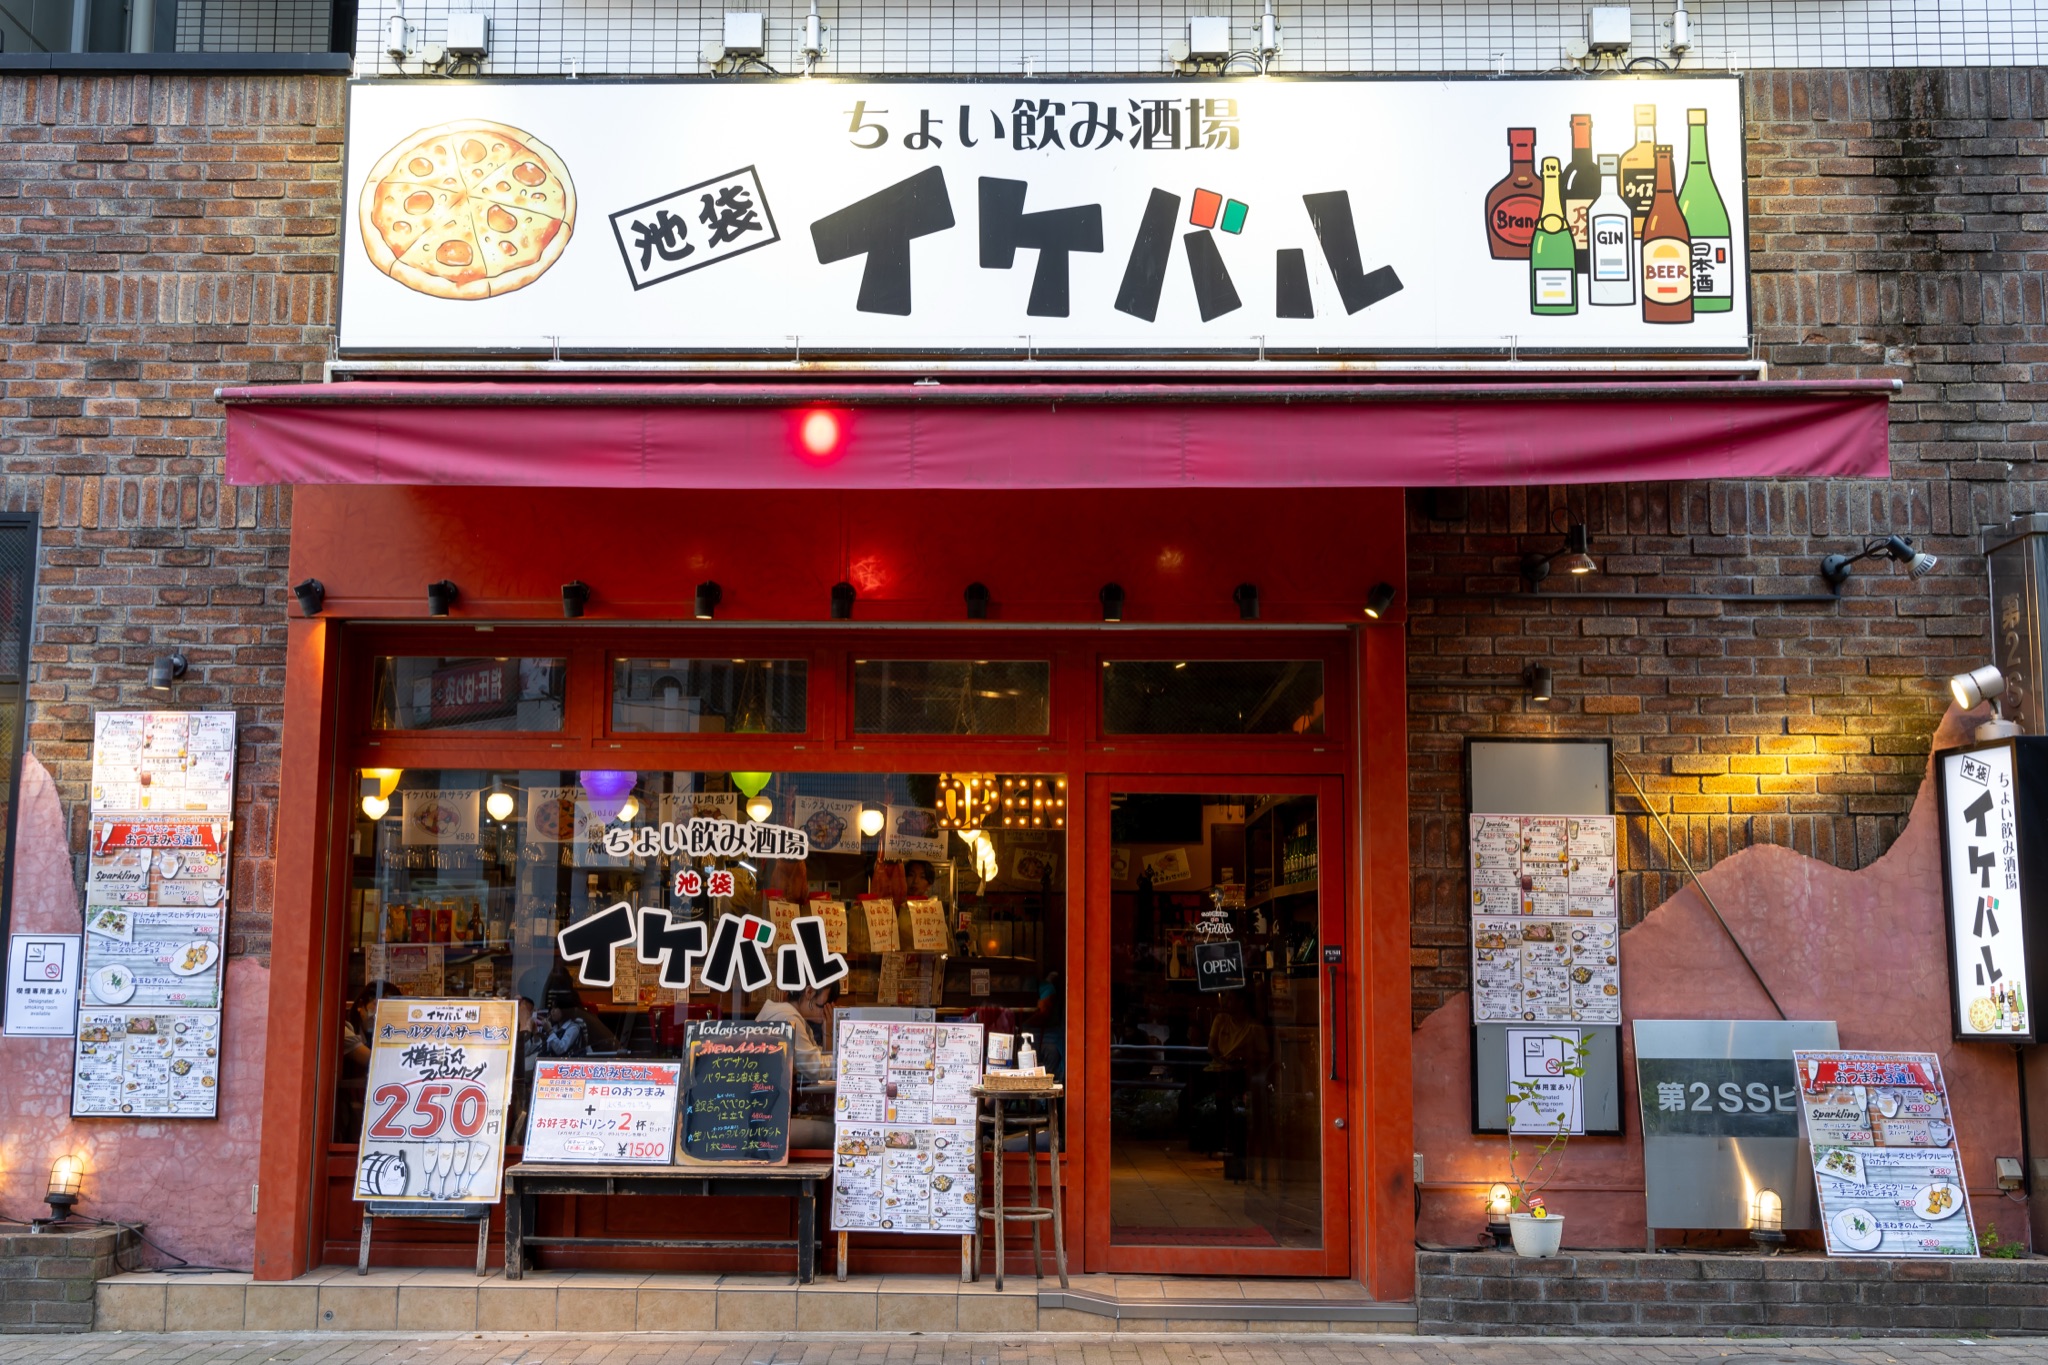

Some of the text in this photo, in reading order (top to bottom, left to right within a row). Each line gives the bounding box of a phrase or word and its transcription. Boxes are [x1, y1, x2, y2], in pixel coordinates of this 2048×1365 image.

[843, 98, 1240, 151] ちょい飲み酒場
[632, 185, 763, 271] 池袋
[810, 164, 1404, 323] イケバル
[1597, 231, 1623, 244] GIN
[1645, 265, 1689, 280] BEER
[1963, 760, 1987, 781] 池袋
[540, 789, 587, 800] マルゲリー
[662, 794, 734, 805] イケバル肉盛り
[936, 779, 1066, 828] OPEN
[456, 832, 475, 841] ¥580
[604, 818, 807, 859] ちょい飲み酒場
[1998, 772, 2017, 890] ちょい飲み酒場
[125, 834, 202, 846] おつまみ3選!!
[95, 870, 141, 882] Sparkling
[184, 865, 209, 873] ¥980
[677, 872, 734, 897] 池袋
[1963, 789, 2003, 986] イケバル
[120, 892, 146, 900] ¥250
[559, 903, 847, 990] イケバル
[1203, 958, 1237, 974] OPEN
[427, 1010, 461, 1020] イケバル
[381, 1024, 509, 1039] オールタイムサービス
[699, 1021, 785, 1039] Today's special
[558, 1065, 652, 1079] ちょい飲みセット
[1835, 1072, 1915, 1084] おつまみ3選!!
[588, 1086, 665, 1097] 本日のおつまみ
[369, 1083, 499, 1138] 250 円
[1812, 1109, 1860, 1121] Sparkling
[1904, 1104, 1931, 1112] ¥980
[1842, 1132, 1871, 1140] ¥250
[618, 1142, 664, 1157] ¥1500
